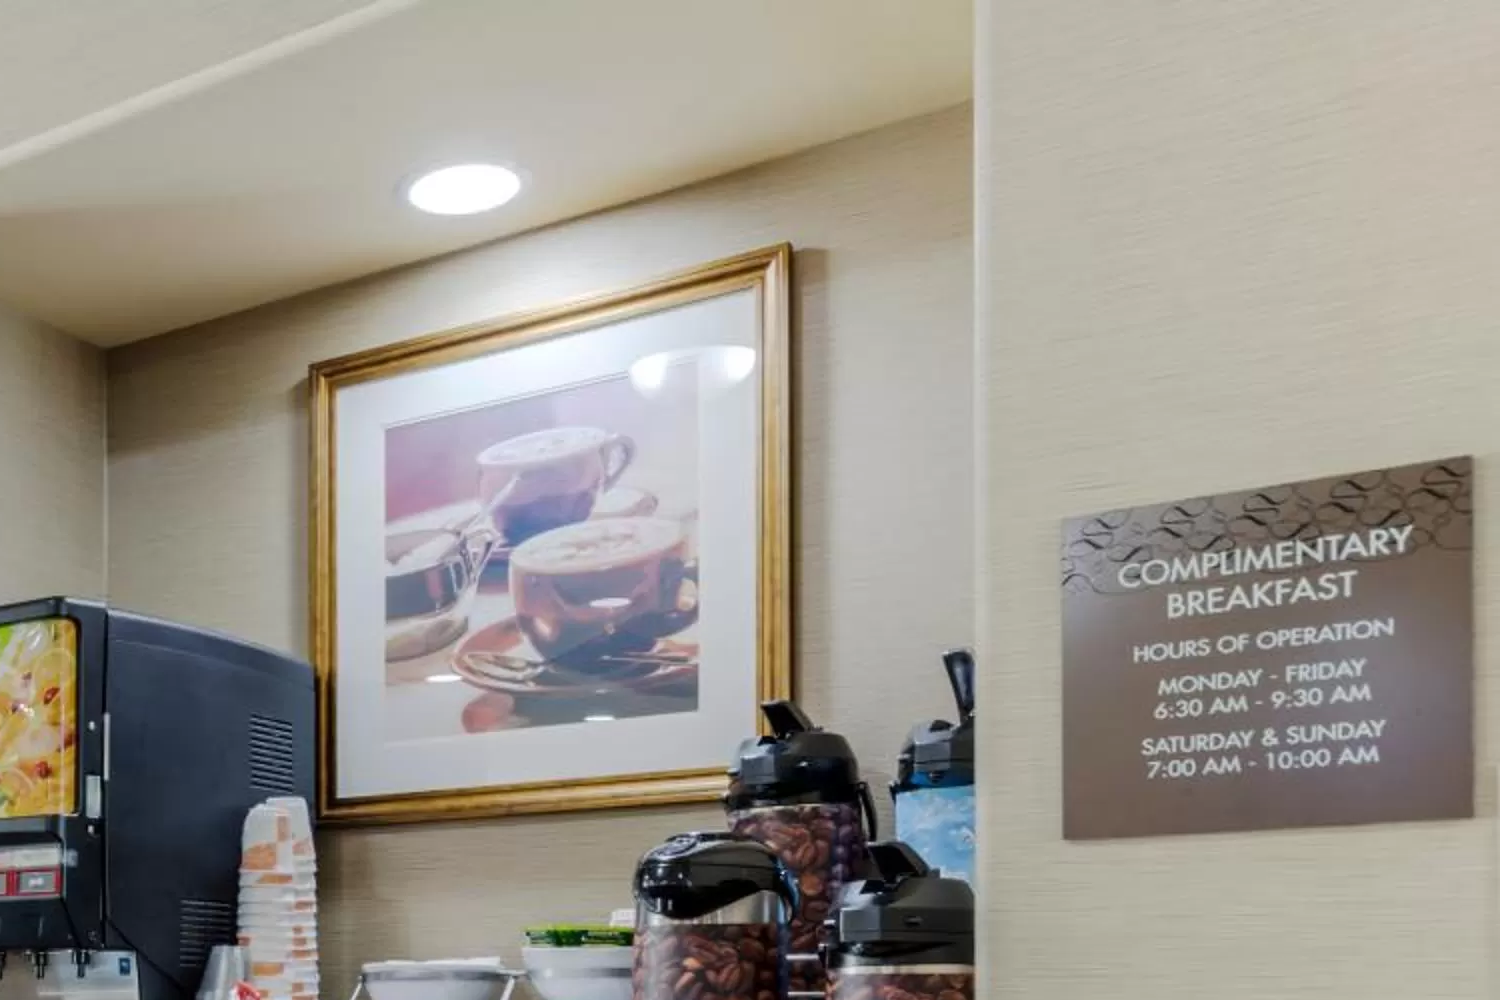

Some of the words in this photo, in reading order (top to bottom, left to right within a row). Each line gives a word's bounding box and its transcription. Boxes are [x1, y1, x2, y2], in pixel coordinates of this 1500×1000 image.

[1119, 525, 1413, 589] COMPLIMENTARY
[1166, 569, 1357, 618] BREAKFAST
[1134, 639, 1210, 662] HOURS
[1217, 634, 1249, 653] OF
[1256, 618, 1394, 649] OPERATION
[1158, 669, 1262, 697] MONDAY
[1286, 659, 1366, 682] FRIDAY
[1154, 700, 1203, 719] 6:30
[1209, 696, 1248, 714] AM
[1271, 689, 1322, 708] 9:30
[1330, 684, 1371, 704] AM
[1142, 730, 1253, 758] SATURDAY
[1262, 728, 1278, 746] &
[1287, 720, 1385, 744] SUNDAY
[1148, 760, 1196, 778] 7:00
[1202, 756, 1241, 774] AM
[1267, 750, 1331, 769] 10:00
[1338, 746, 1379, 764] AM
